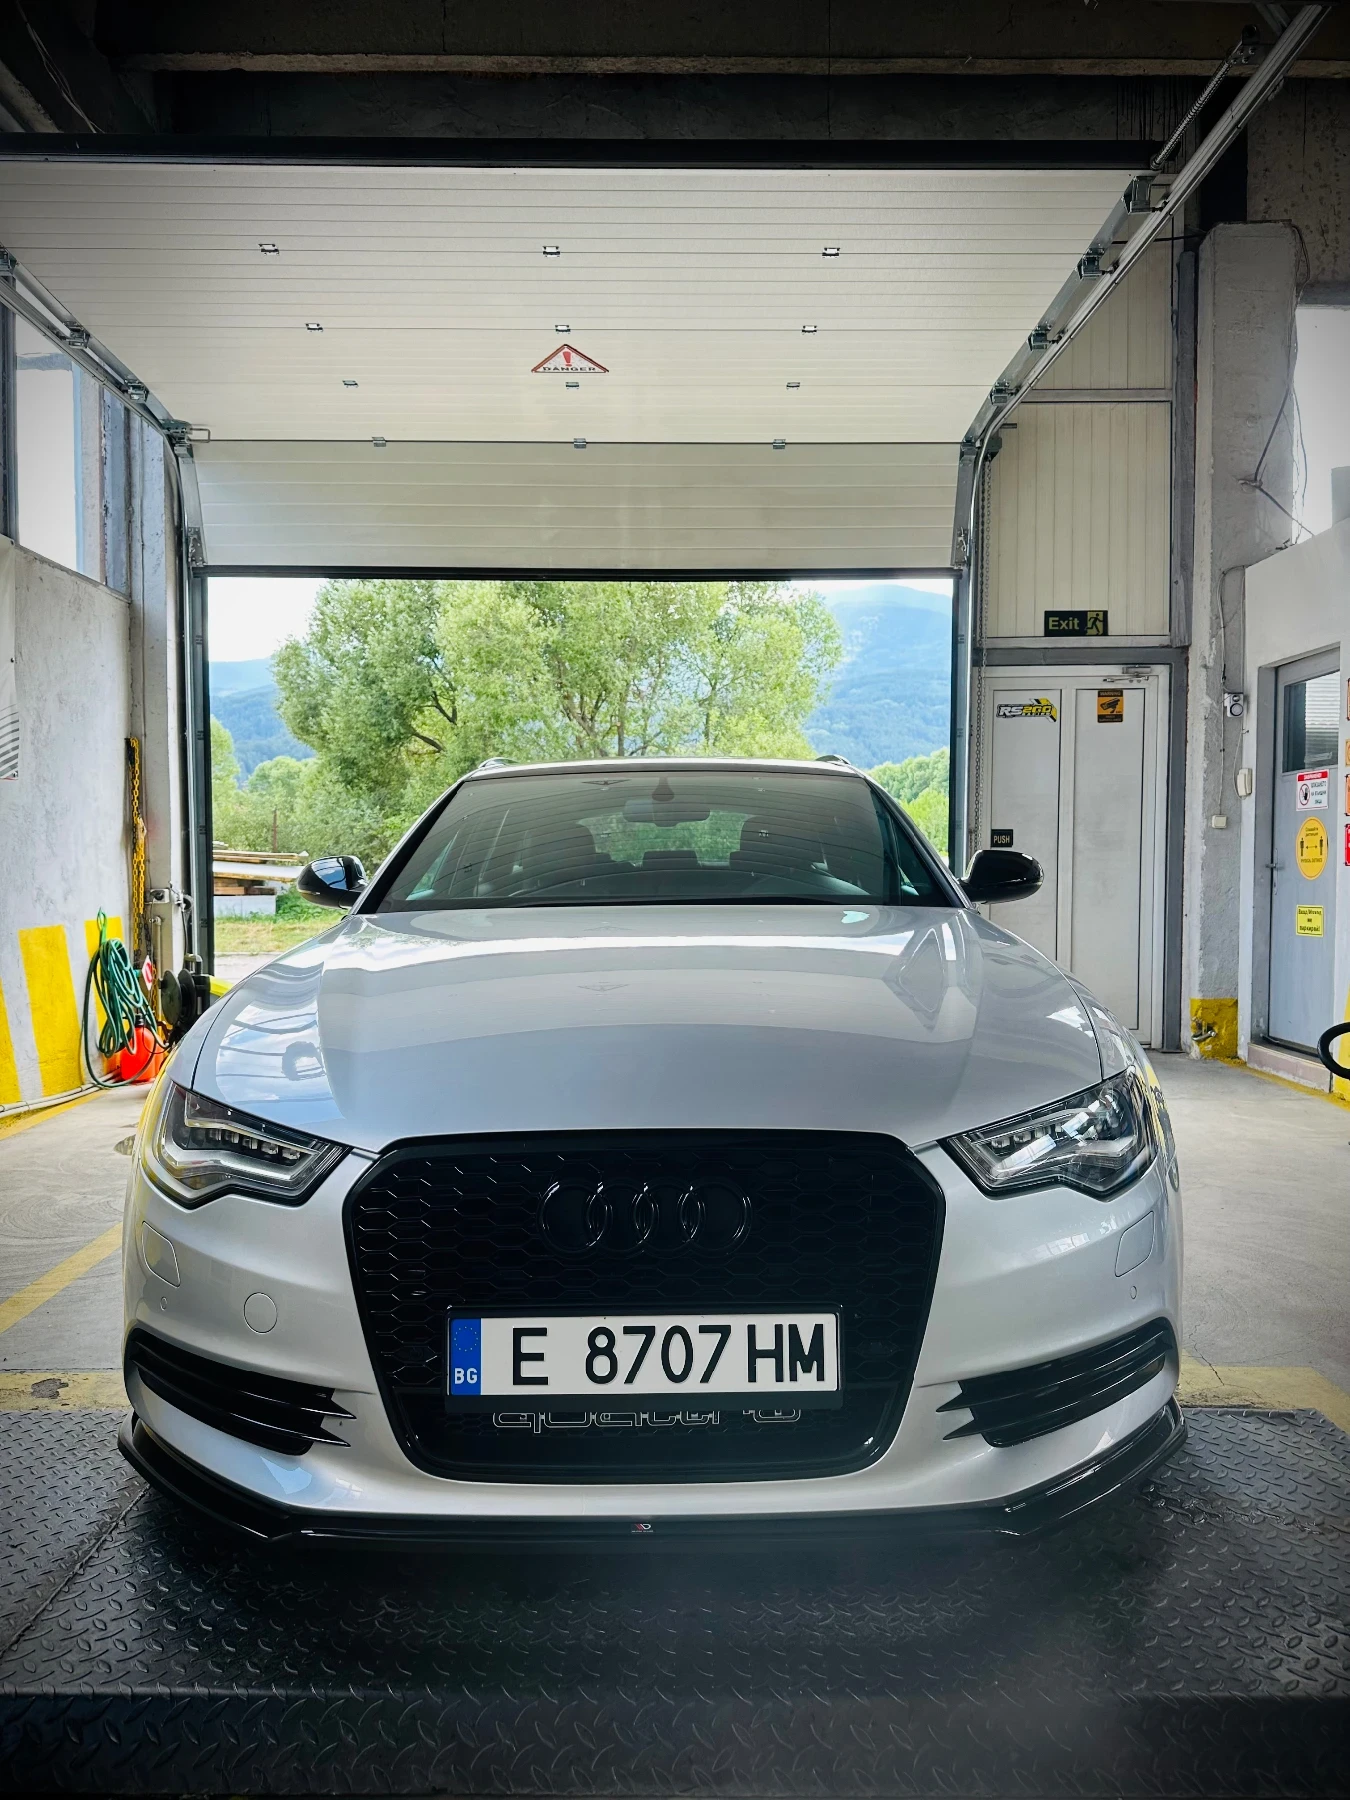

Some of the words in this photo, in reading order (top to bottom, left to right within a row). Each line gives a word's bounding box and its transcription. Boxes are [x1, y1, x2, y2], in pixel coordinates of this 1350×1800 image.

[1048, 616, 1080, 630] Exit
[993, 835, 1010, 844] PUSH
[512, 1326, 549, 1386] E
[585, 1324, 732, 1386] 8707
[747, 1323, 826, 1384] HM
[454, 1367, 478, 1385] BG
